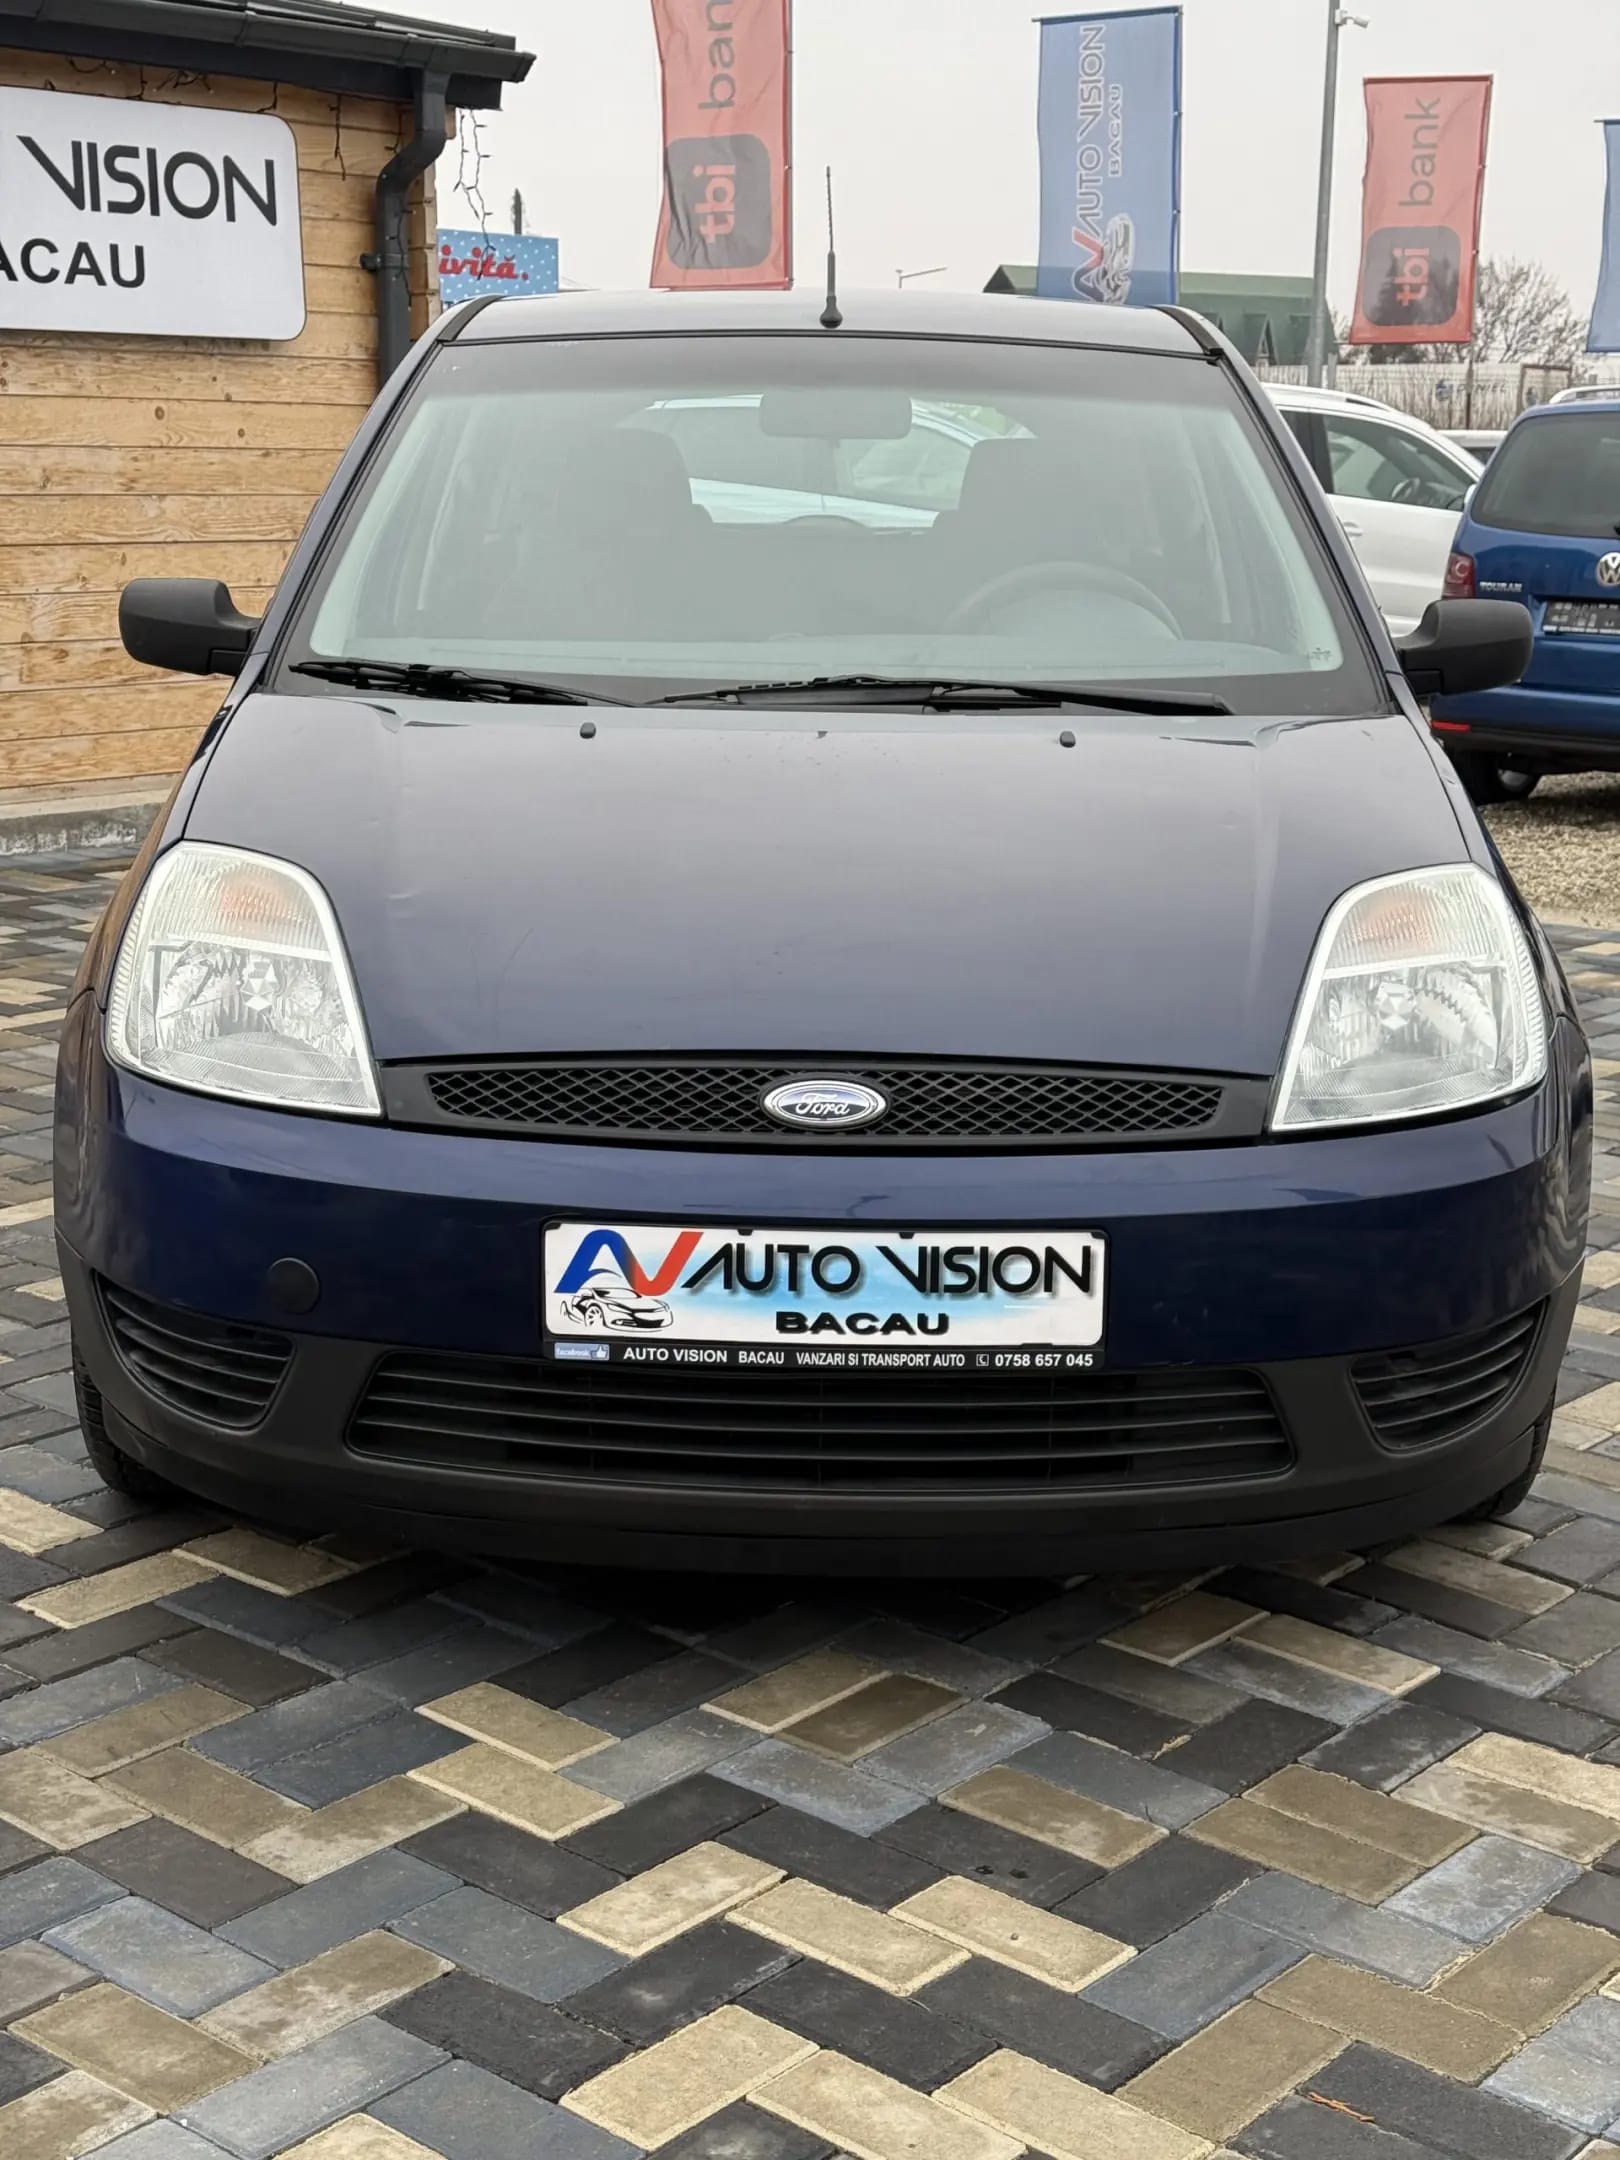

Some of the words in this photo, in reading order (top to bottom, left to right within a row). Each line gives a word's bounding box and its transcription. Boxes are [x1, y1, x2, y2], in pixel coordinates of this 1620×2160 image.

[1078, 24, 1106, 141] VISION
[1108, 84, 1123, 177] BACAU
[1398, 97, 1441, 208] bank
[16, 135, 277, 226] VISION
[693, 165, 736, 244] tbi
[1077, 143, 1104, 238] AUTO
[1392, 248, 1430, 306] tbi
[795, 1092, 851, 1117] Ford
[681, 1243, 861, 1293] AUTO
[875, 1246, 1092, 1294] VISION
[623, 1347, 669, 1361] AUTO
[673, 1348, 728, 1363] VISION
[738, 1350, 785, 1365] BACAU
[796, 1352, 845, 1366] VANZARI
[848, 1353, 859, 1366] SI
[861, 1353, 931, 1367] TRANSPORT
[933, 1354, 966, 1367] AUTO
[995, 1353, 1031, 1367] 0758
[1035, 1353, 1061, 1367] 657
[1066, 1353, 1093, 1367] 045
[775, 1311, 950, 1336] BACAU
